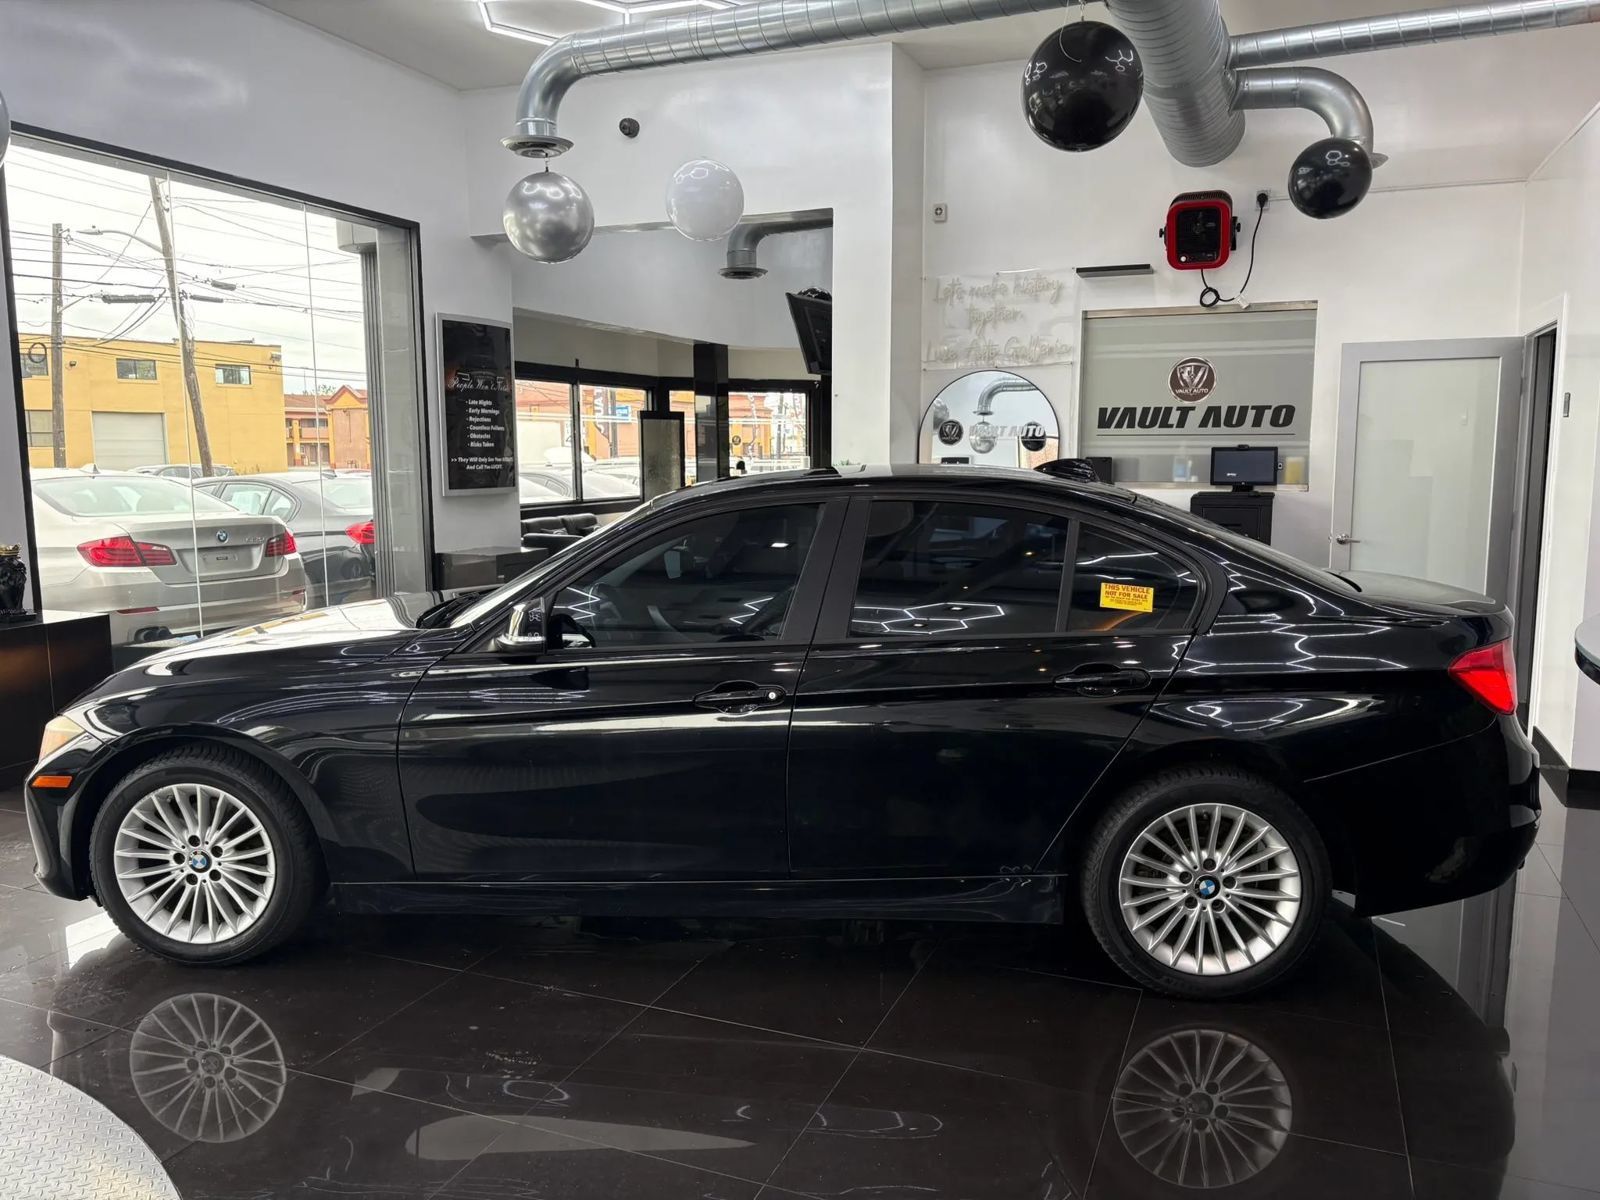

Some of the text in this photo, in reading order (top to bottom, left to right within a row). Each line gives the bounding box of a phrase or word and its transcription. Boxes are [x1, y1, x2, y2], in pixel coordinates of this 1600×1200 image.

[478, 399, 493, 407] Nights
[1097, 404, 1296, 429] VAULT AUTO
[1008, 425, 1045, 437] AUTO
[1121, 585, 1150, 594] VEHICLE
